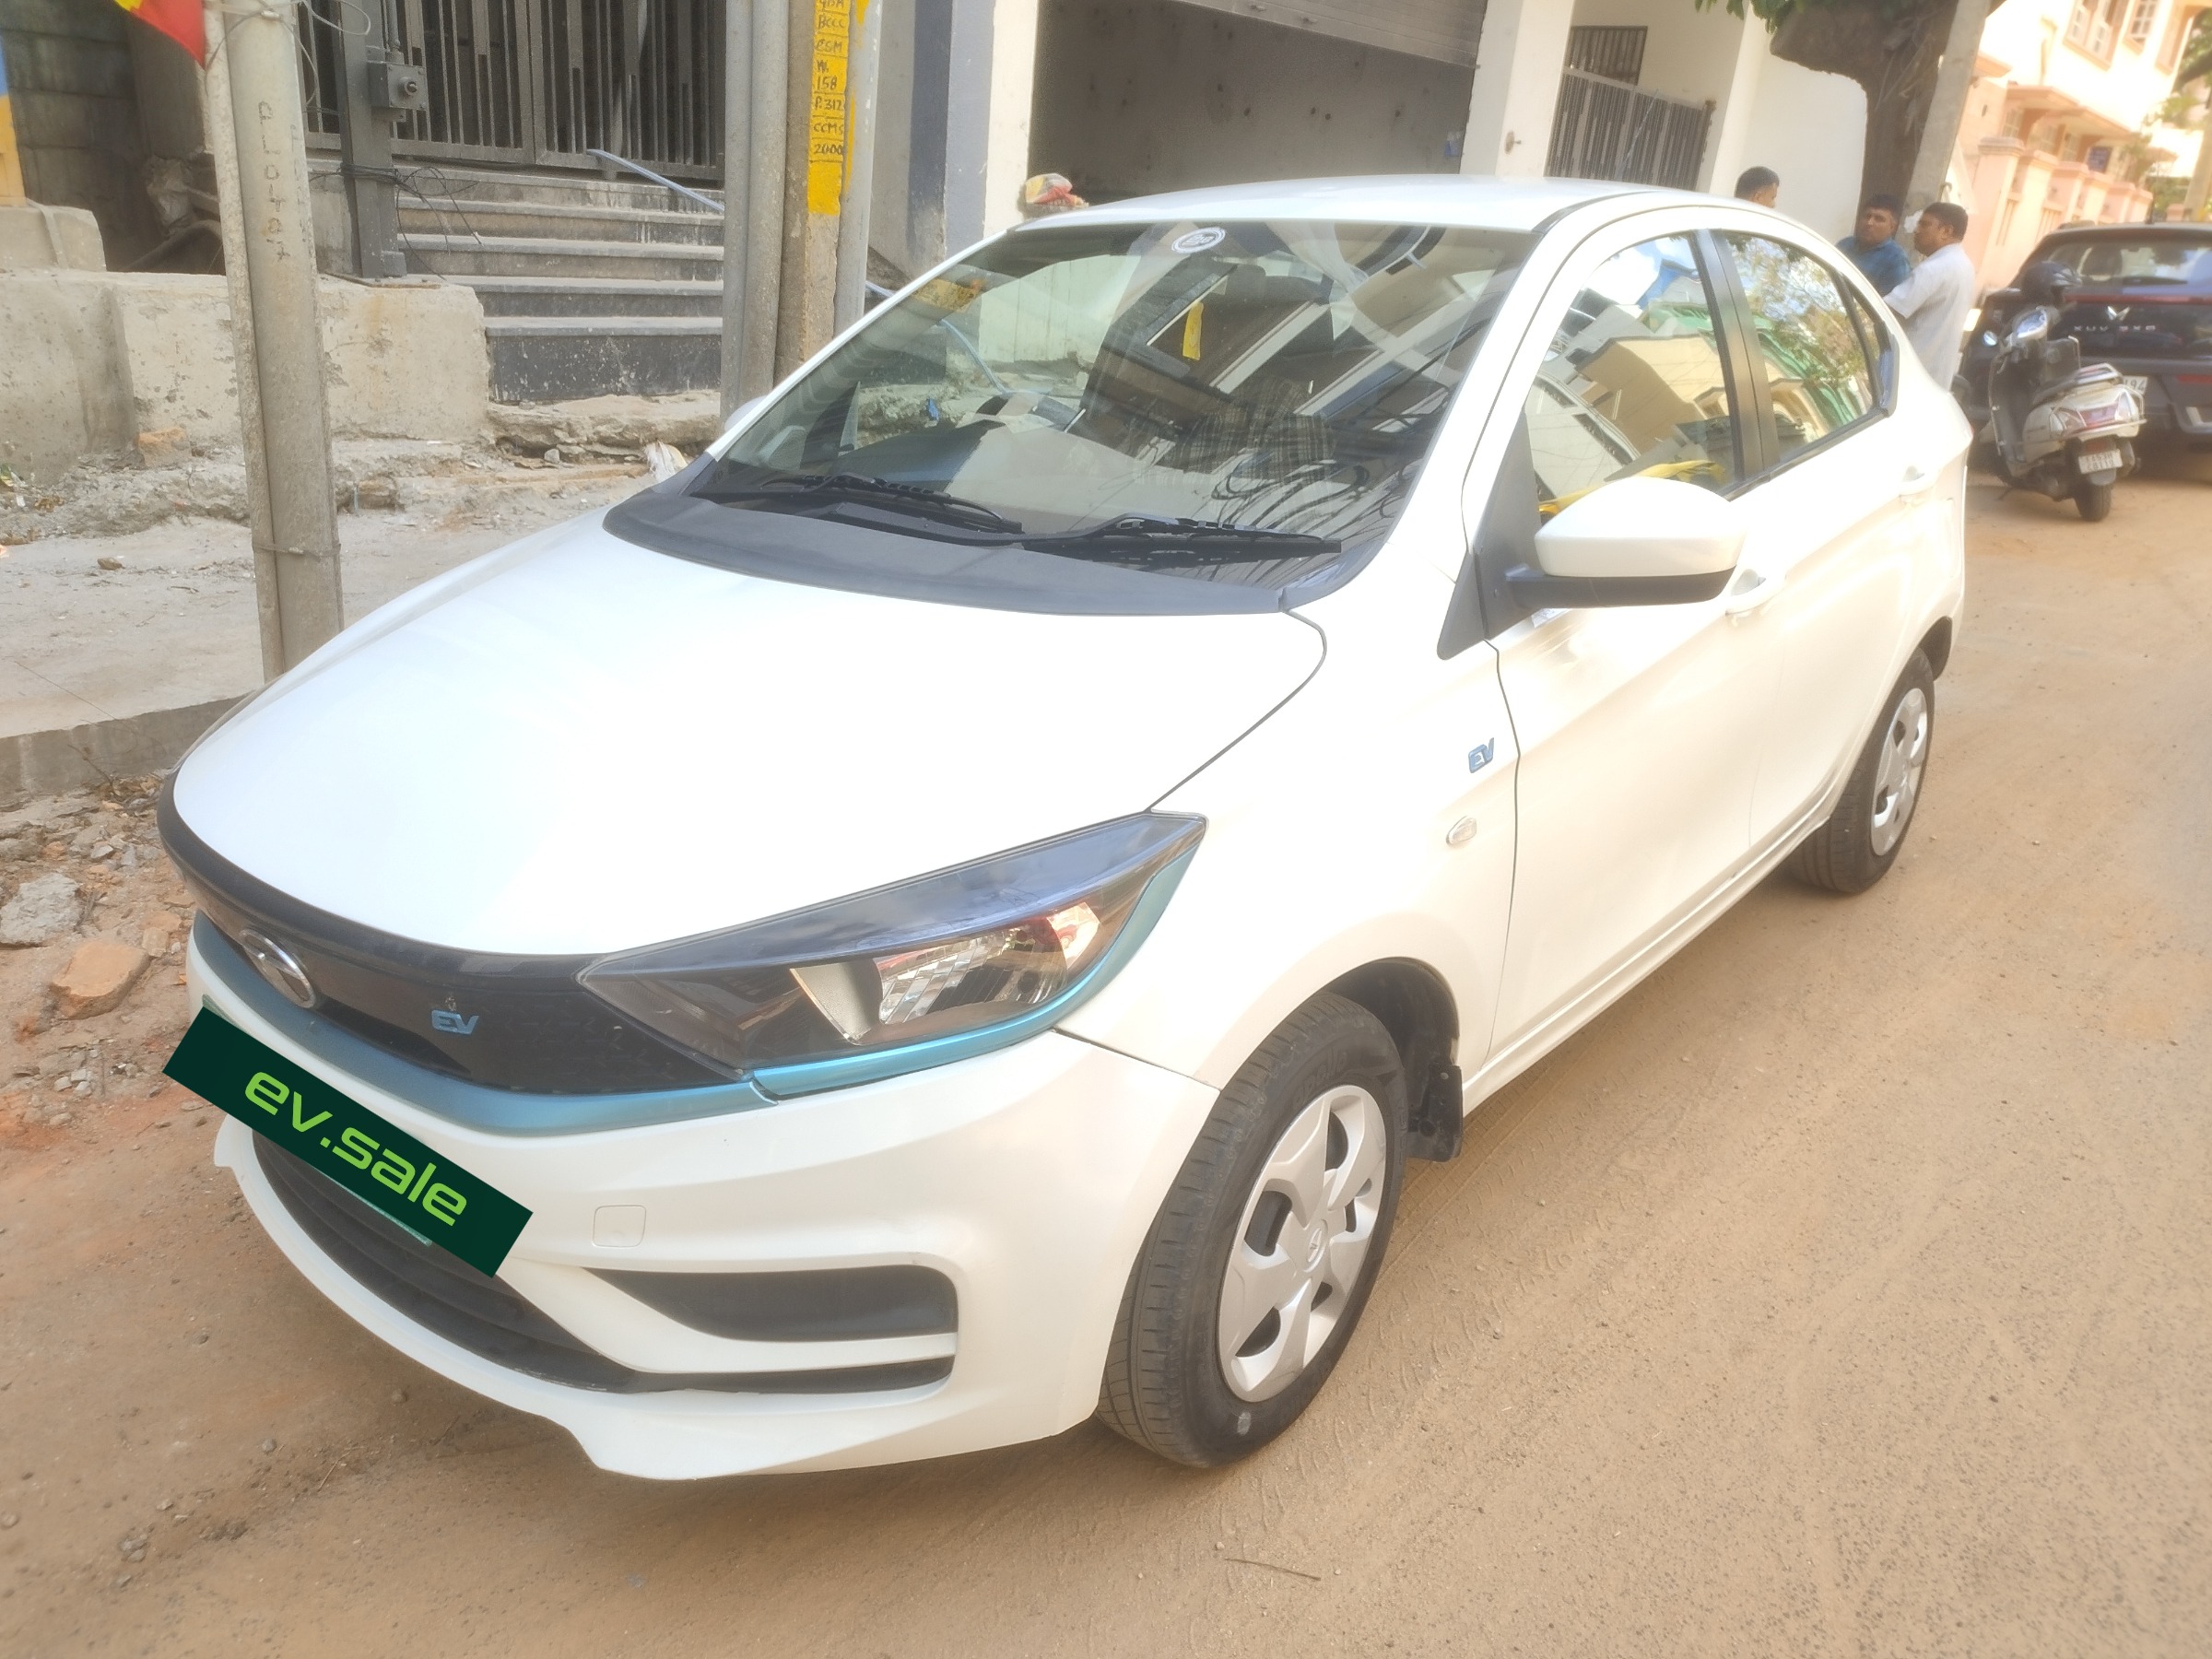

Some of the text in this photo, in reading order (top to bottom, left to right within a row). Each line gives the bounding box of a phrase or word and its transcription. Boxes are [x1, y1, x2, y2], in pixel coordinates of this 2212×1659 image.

[817, 76, 837, 91] 158
[1468, 737, 1494, 773] EV
[431, 1010, 479, 1034] EV
